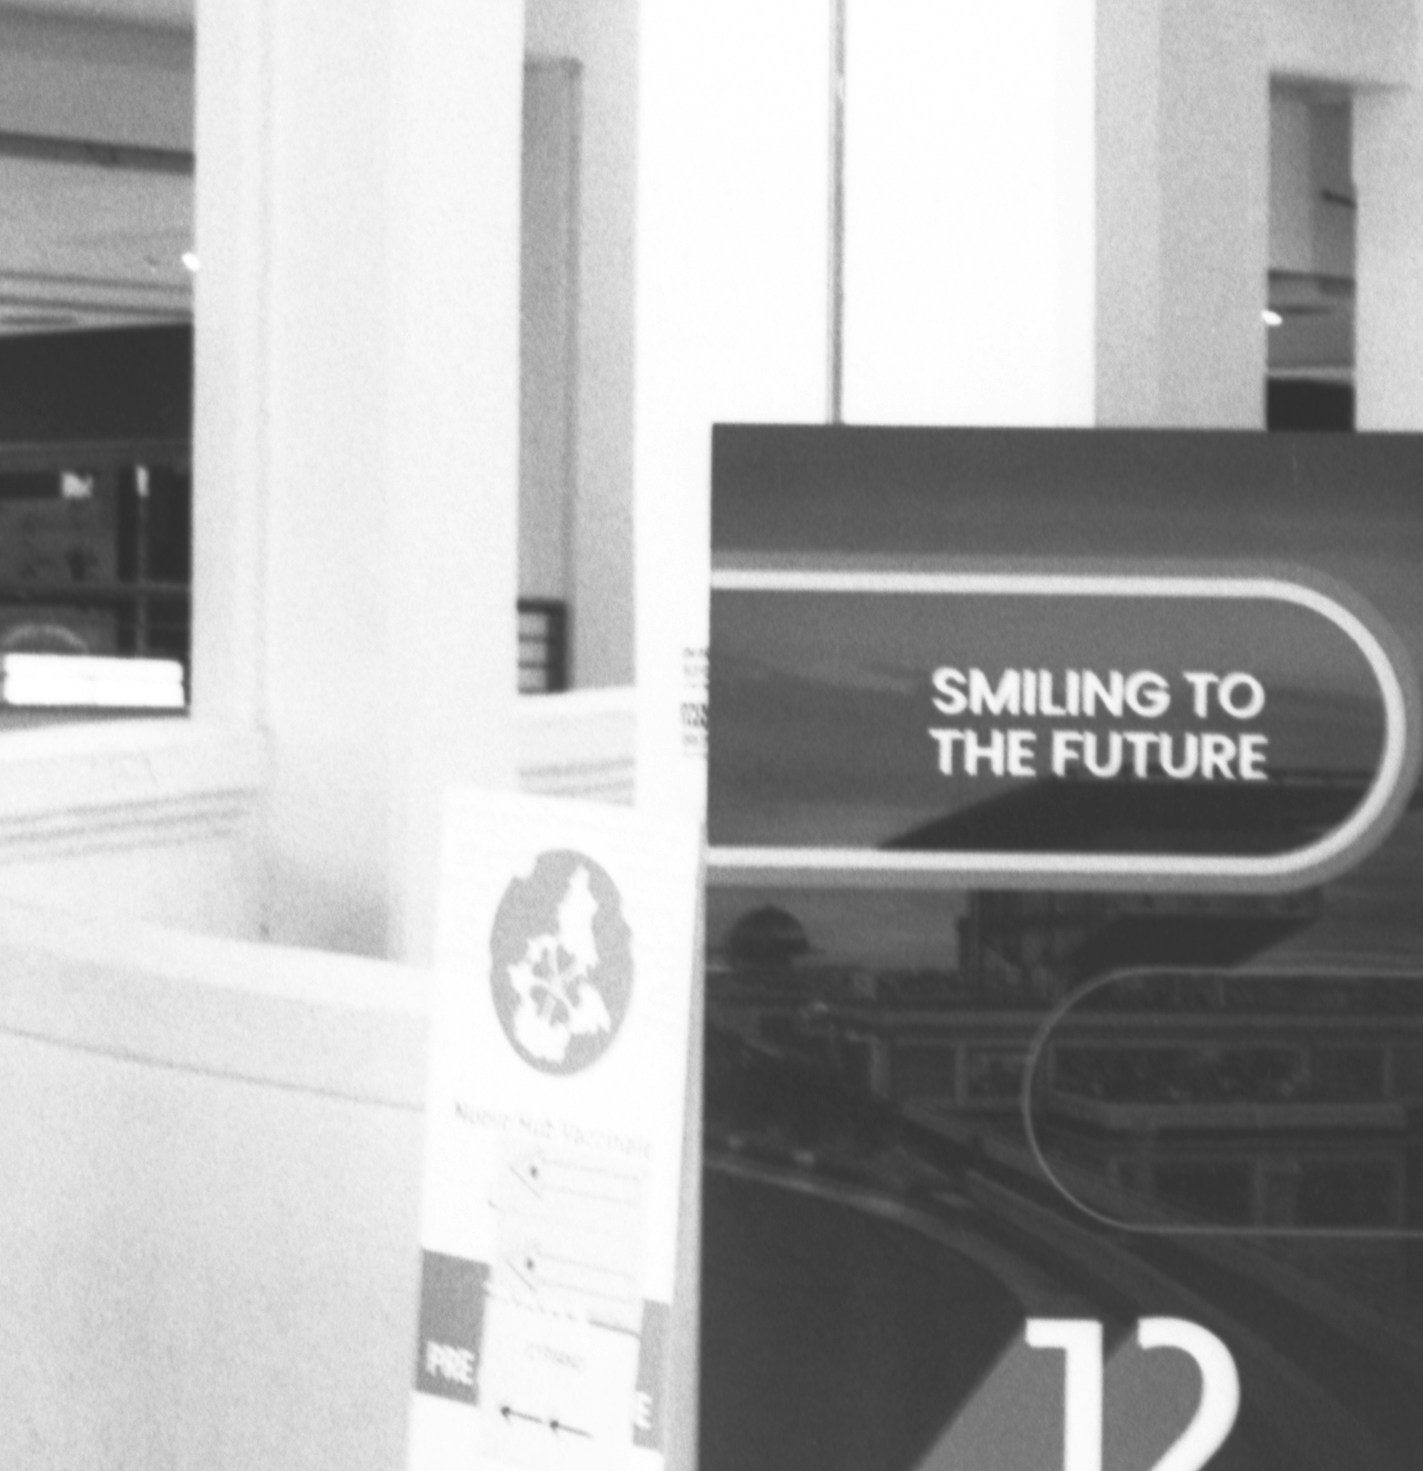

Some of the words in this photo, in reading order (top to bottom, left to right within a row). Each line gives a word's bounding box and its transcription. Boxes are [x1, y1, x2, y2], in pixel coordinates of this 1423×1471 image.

[931, 666, 1171, 718] SMILING
[1181, 670, 1266, 719] TO
[928, 727, 1037, 777] THE
[1051, 729, 1269, 780] FUTURE
